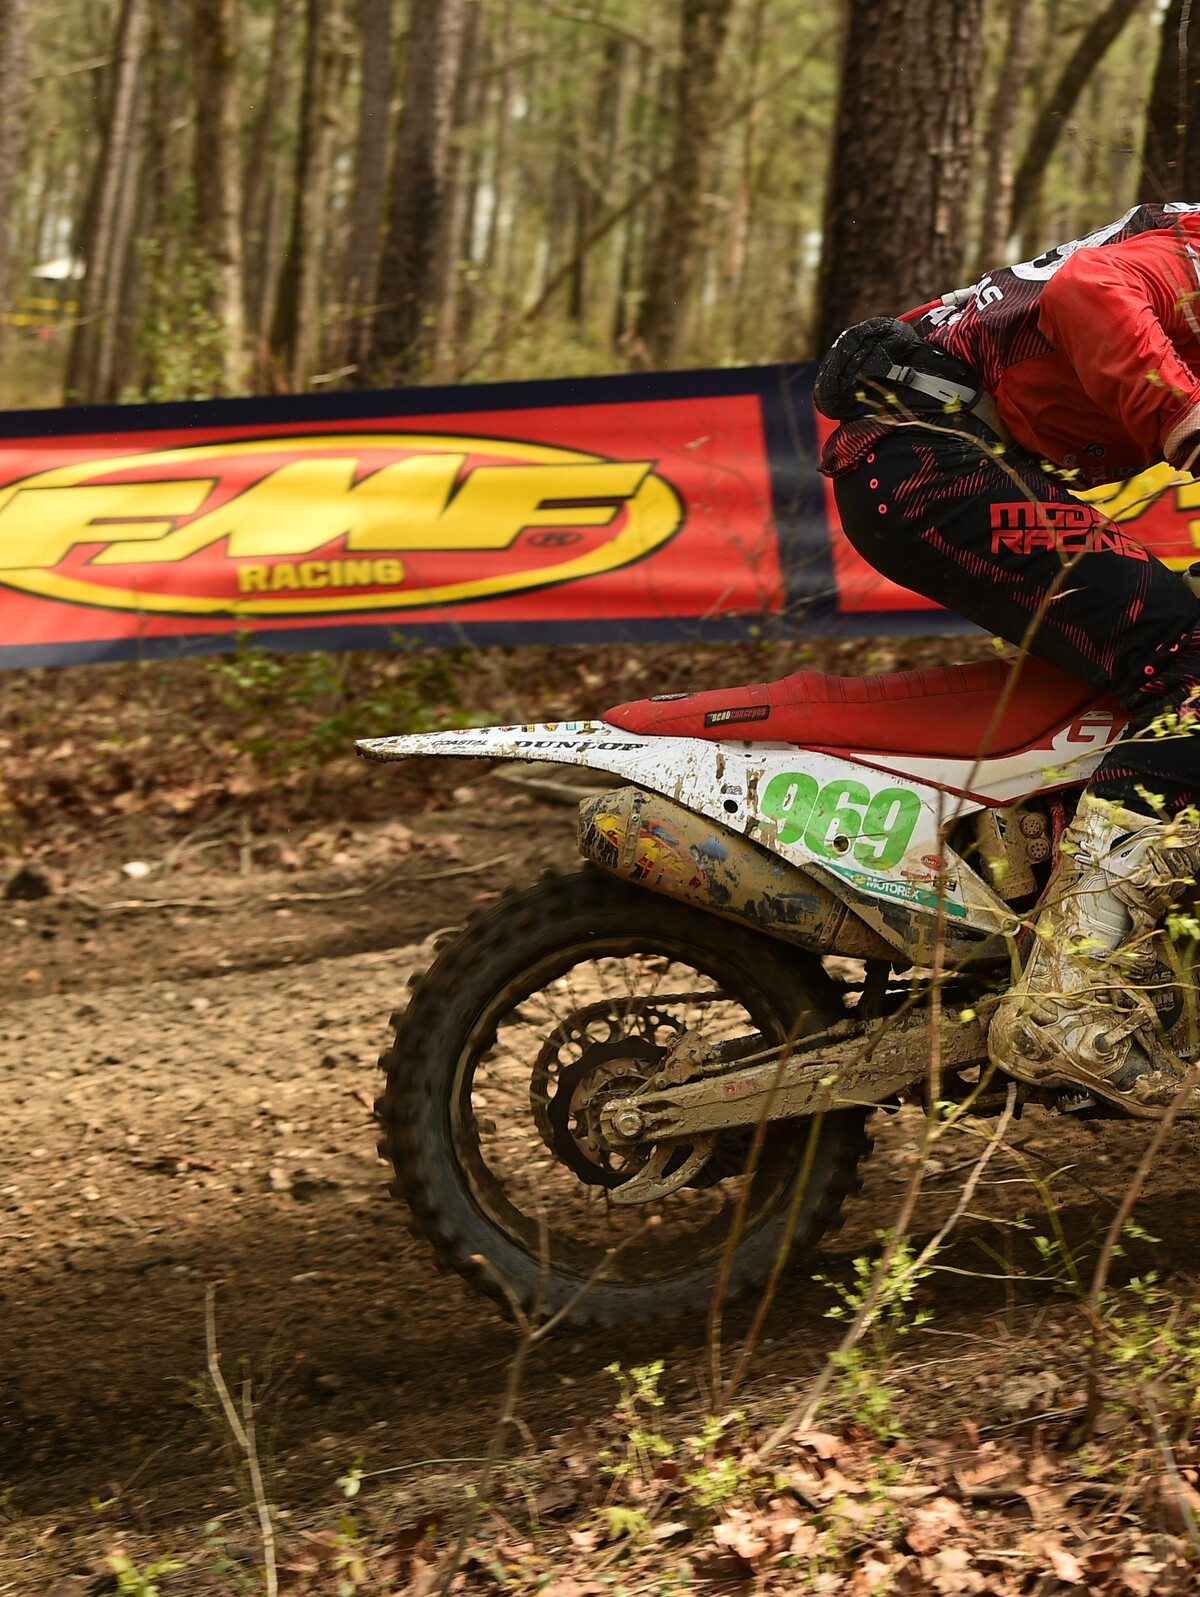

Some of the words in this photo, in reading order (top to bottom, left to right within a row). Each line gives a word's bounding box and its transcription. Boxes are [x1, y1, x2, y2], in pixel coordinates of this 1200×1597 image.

[0, 452, 657, 569] FMF
[991, 528, 1149, 563] RACING
[238, 558, 405, 594] RACING
[513, 740, 647, 751] DUNLOP
[757, 771, 922, 871] 969
[865, 876, 920, 900] MOTOREX
